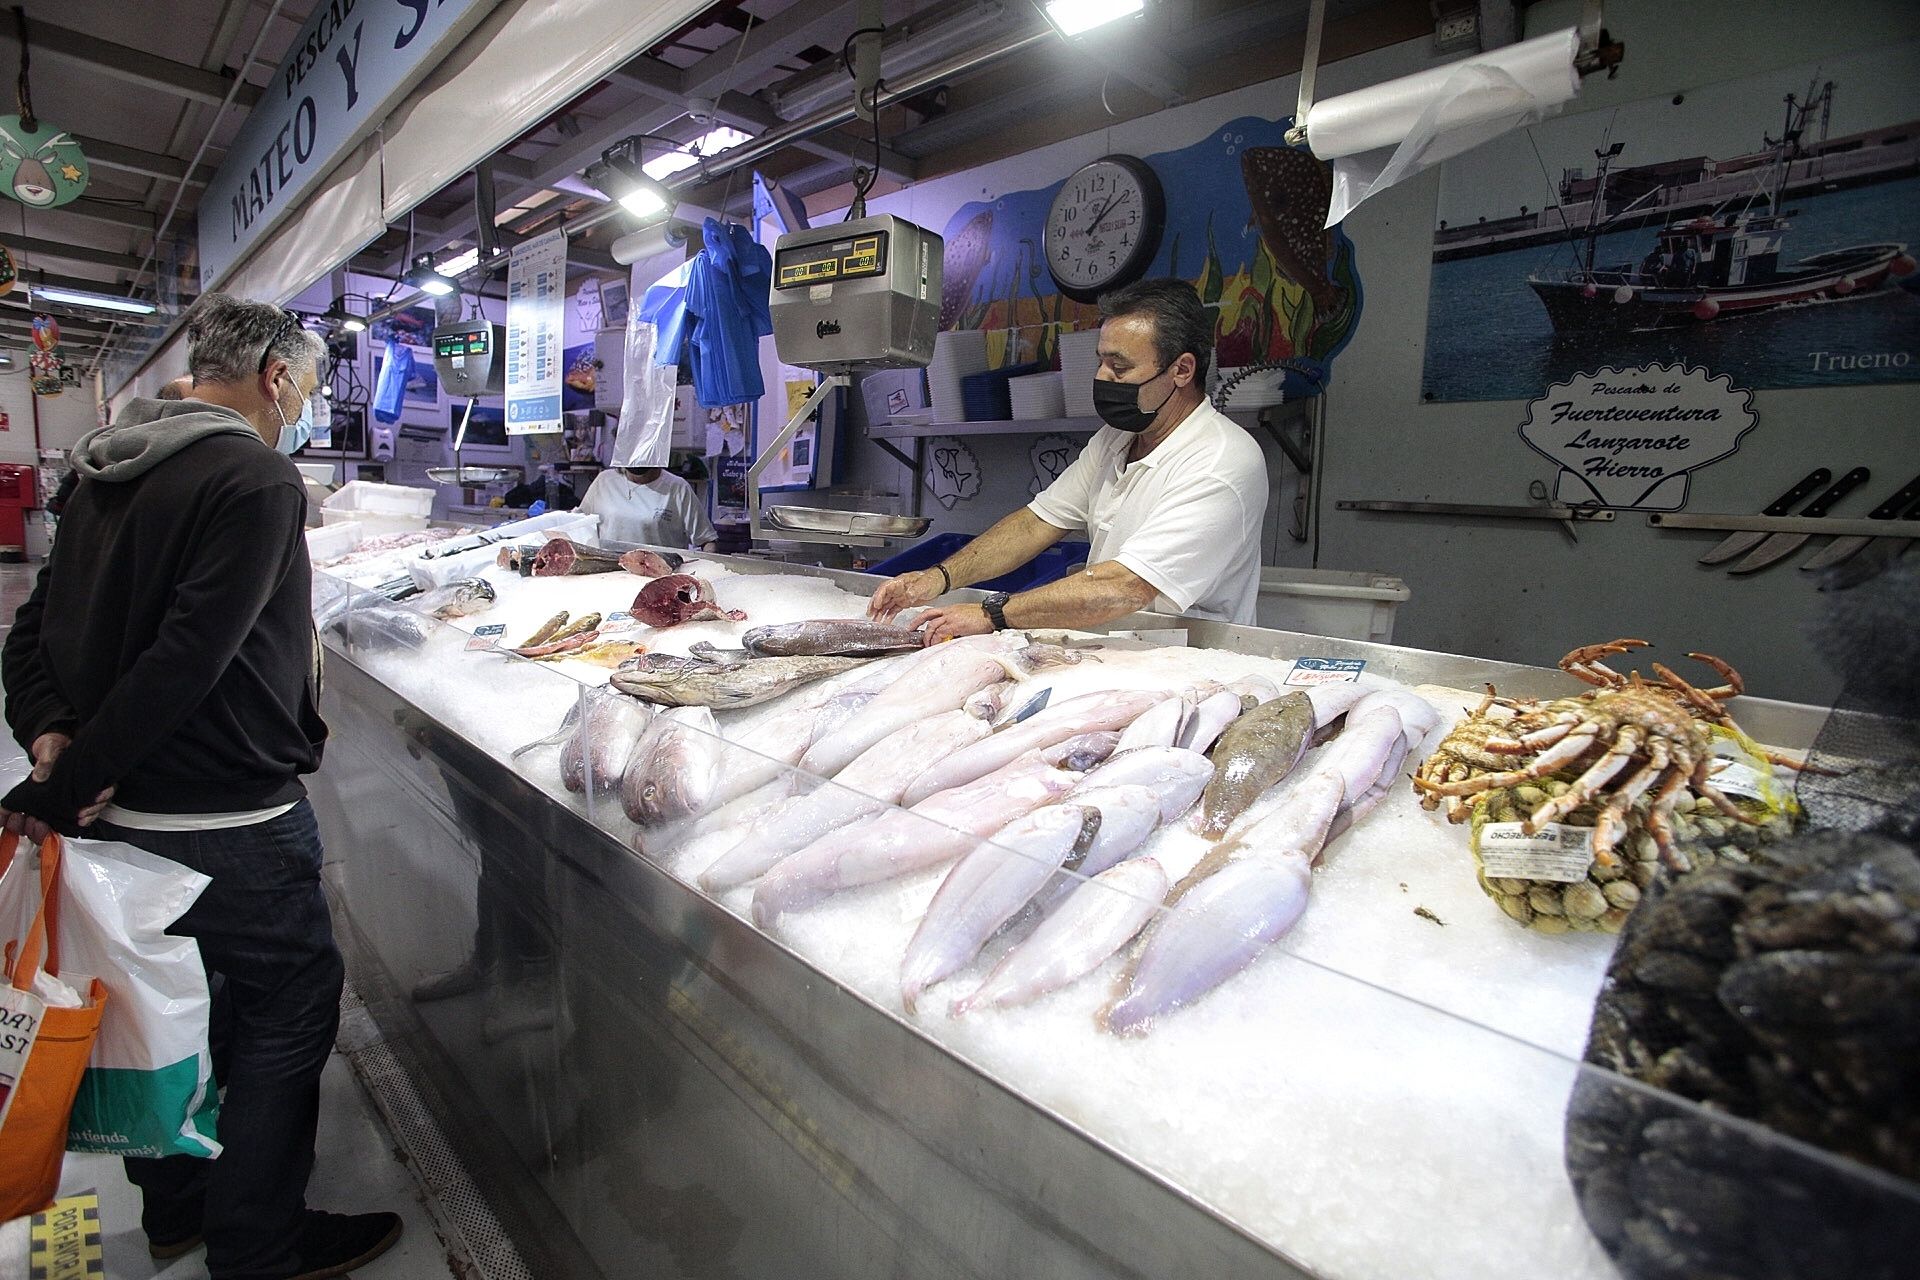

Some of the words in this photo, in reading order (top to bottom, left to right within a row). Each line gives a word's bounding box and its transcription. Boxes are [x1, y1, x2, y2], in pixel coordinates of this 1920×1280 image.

[231, 95, 317, 244] MATEO
[335, 18, 364, 112] Y
[1091, 176, 1105, 192] 12
[1111, 179, 1117, 193] 1
[1076, 188, 1087, 203] 11
[1064, 206, 1077, 222] 10
[1127, 210, 1136, 226] 3
[1057, 226, 1066, 240] 9
[1120, 232, 1129, 247] 4
[1061, 246, 1070, 261] 8
[1108, 250, 1117, 266] 5
[1075, 257, 1083, 272] 7
[1088, 260, 1098, 275] 6
[1808, 351, 1910, 372] Trueno
[1591, 382, 1657, 395] Pescados
[1663, 382, 1682, 394] de
[1550, 401, 1723, 425] Fuerteventura
[1564, 429, 1691, 456] Lanzarote
[1583, 456, 1665, 478] Hierro
[0, 1034, 30, 1055] ST
[82, 1128, 129, 1144] tienda
